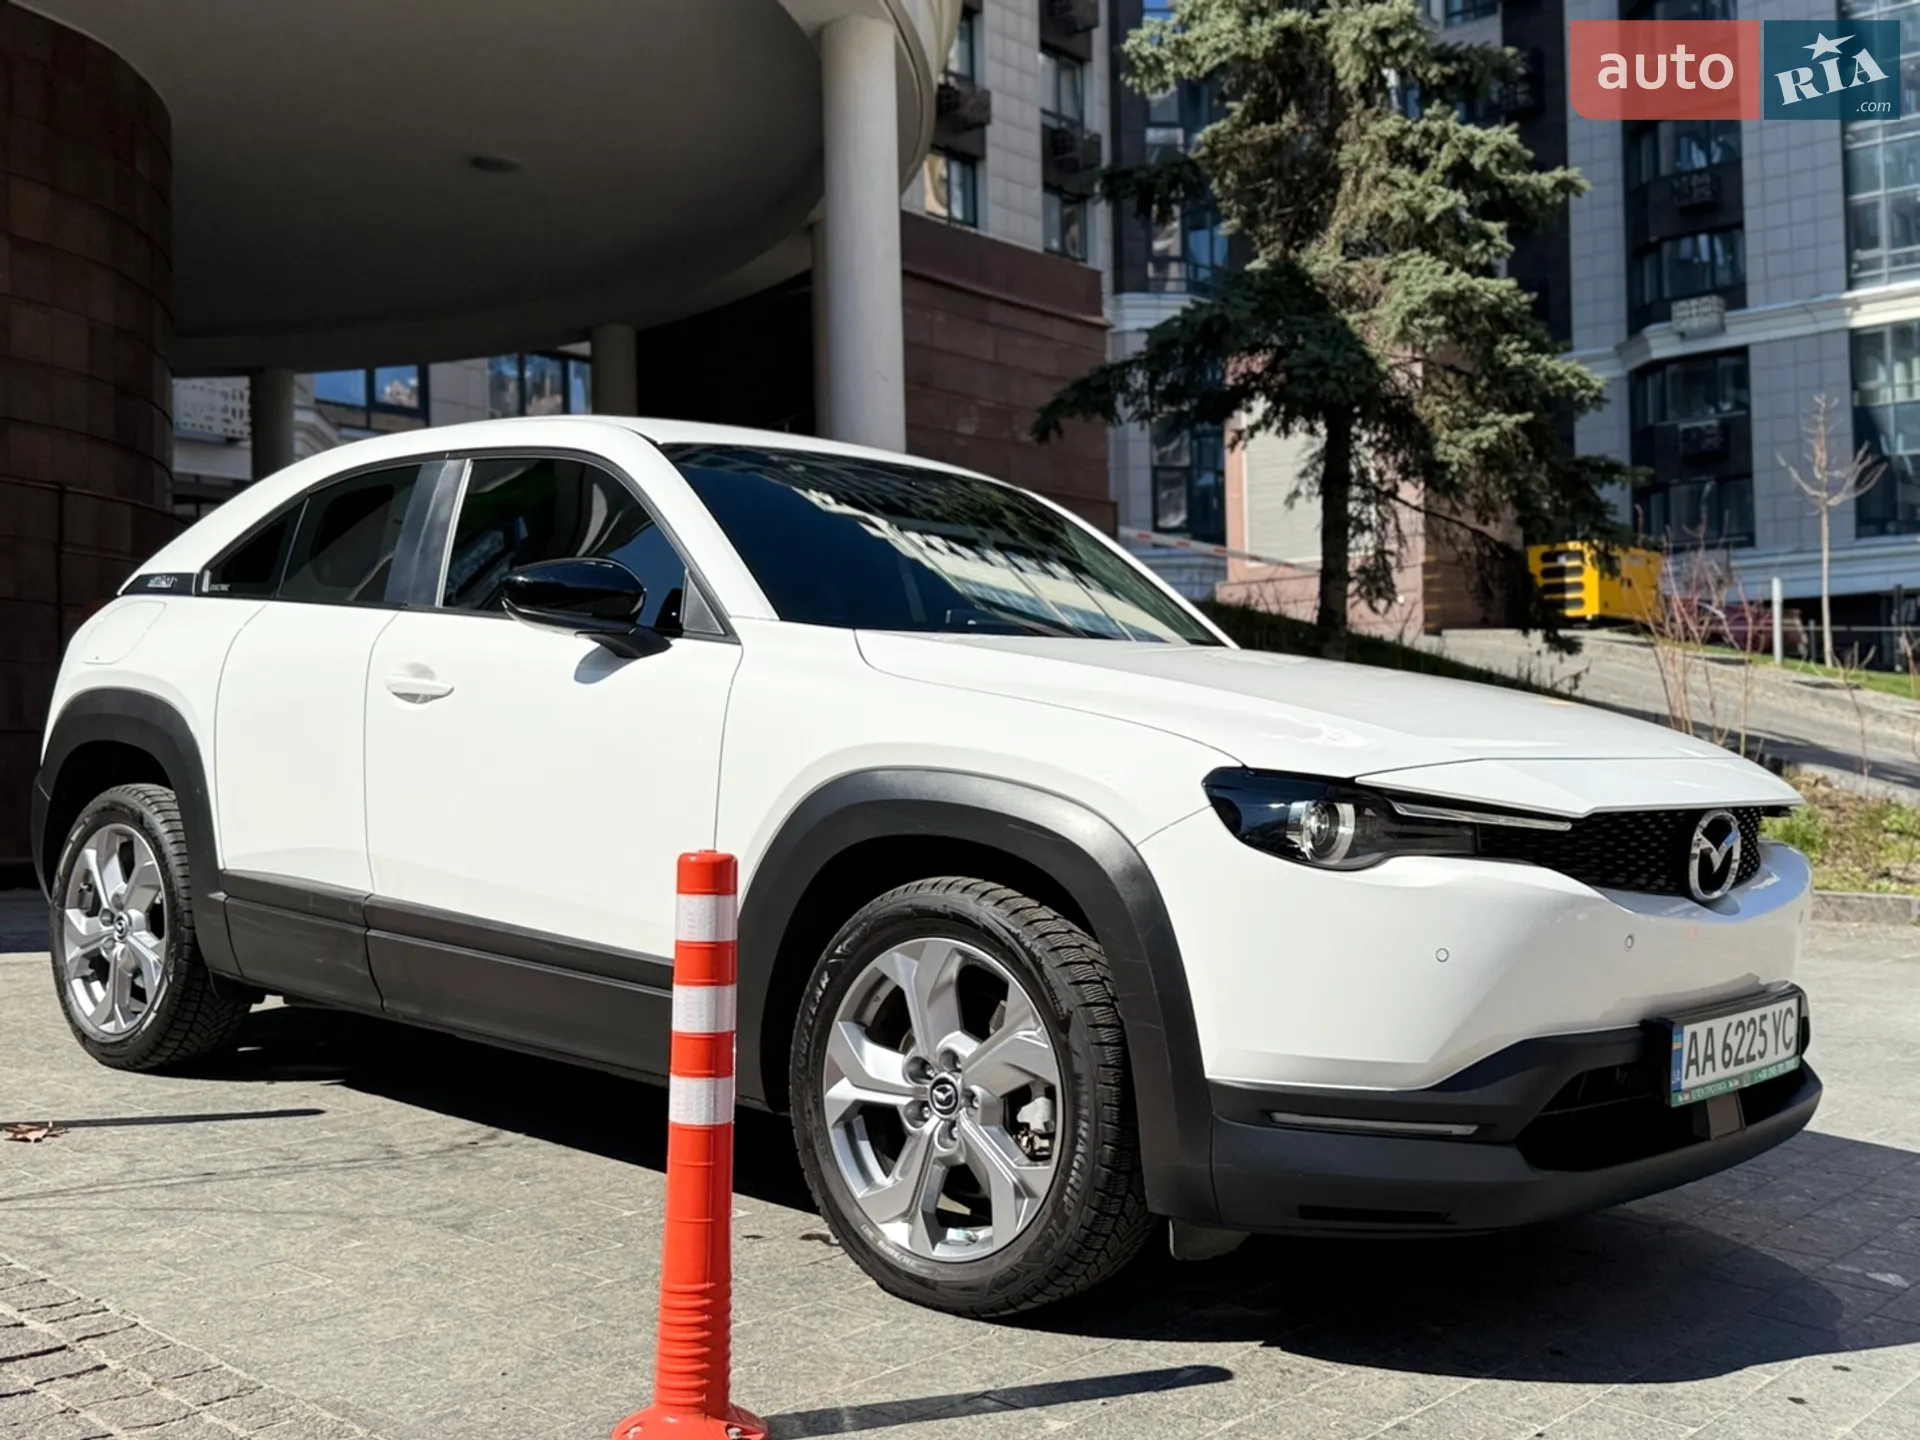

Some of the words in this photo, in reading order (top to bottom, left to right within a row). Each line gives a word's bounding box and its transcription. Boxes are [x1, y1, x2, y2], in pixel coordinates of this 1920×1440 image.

[1685, 1027, 1716, 1080] AA
[1721, 1013, 1767, 1069] 6225
[1772, 1007, 1794, 1055] YC
